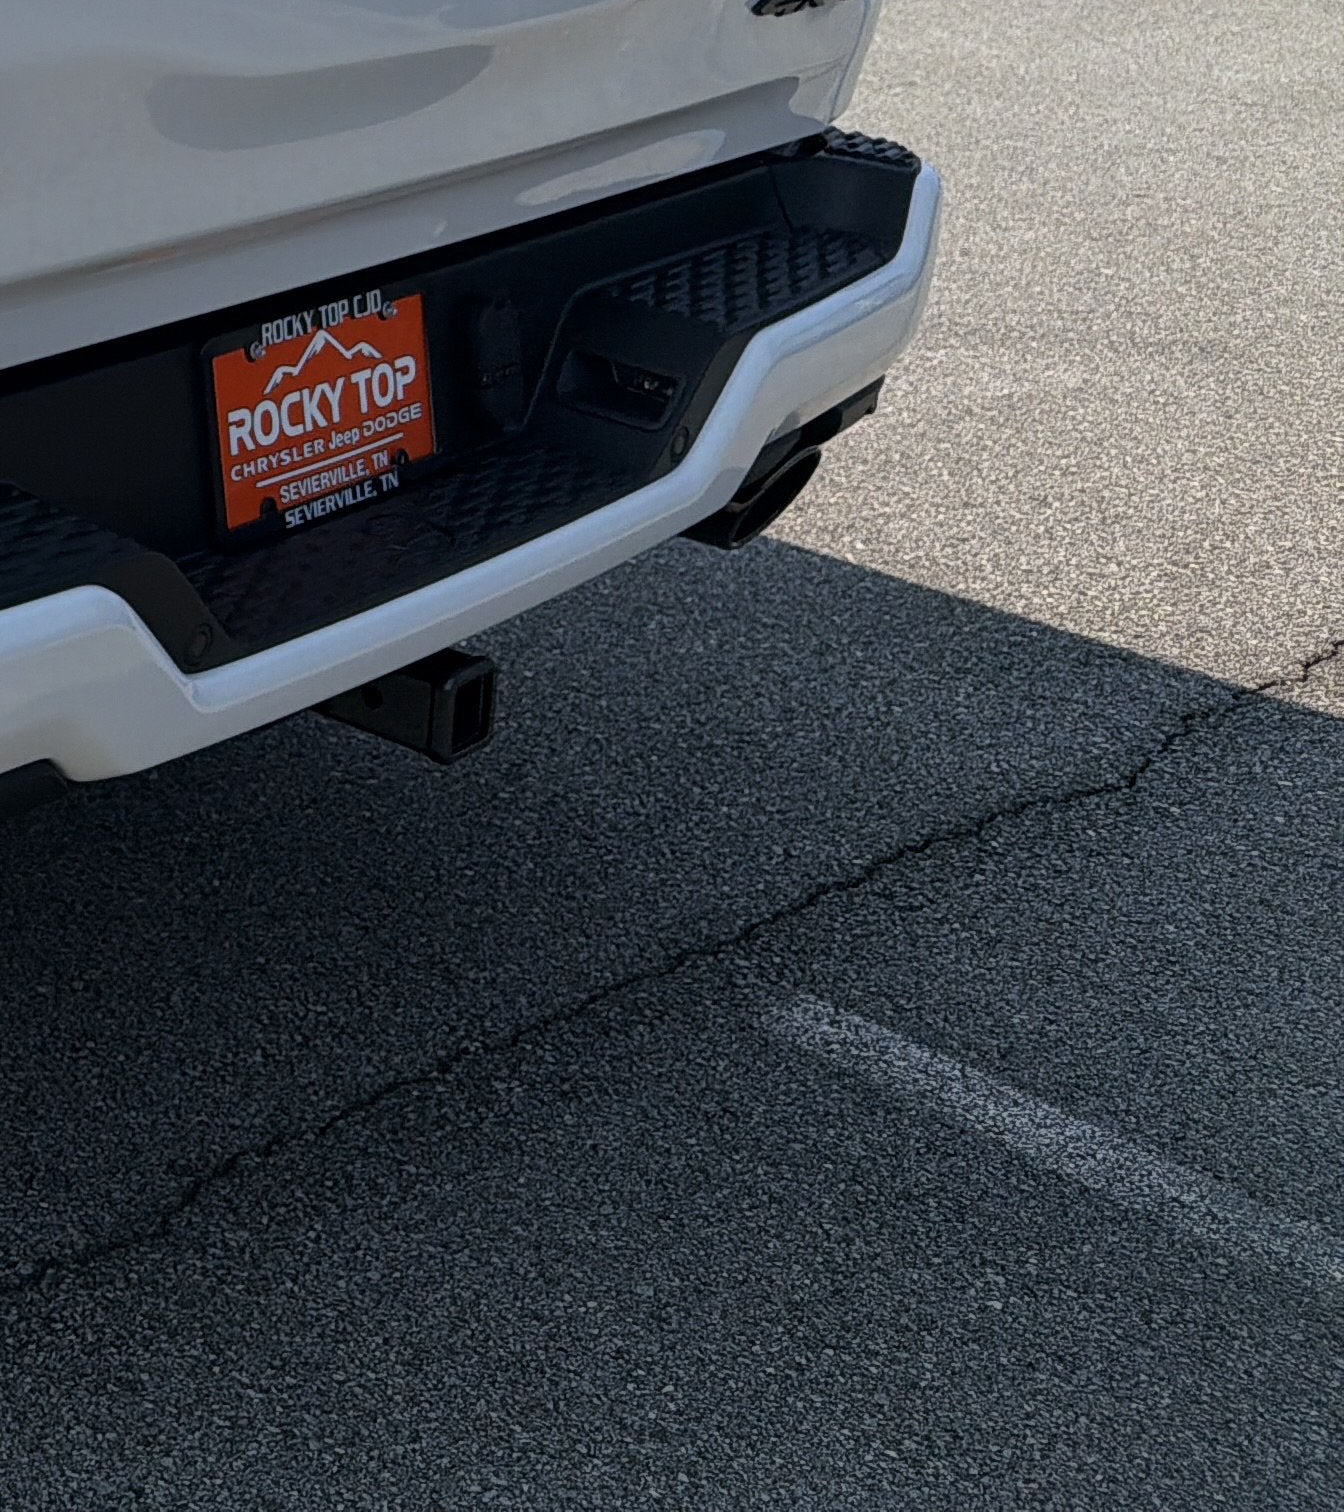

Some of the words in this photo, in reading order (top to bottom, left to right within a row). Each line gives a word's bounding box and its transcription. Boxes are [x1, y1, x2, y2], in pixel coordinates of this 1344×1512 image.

[262, 309, 314, 348] ROCKY
[318, 300, 350, 329] TOP
[353, 289, 382, 318] CJD
[227, 376, 345, 456] ROCKY
[351, 355, 416, 414] TOP
[230, 438, 325, 481] CHRYSLER
[329, 428, 360, 450] Jeep
[363, 402, 423, 437] DODGE
[371, 449, 390, 470] TN
[379, 469, 400, 492] TN
